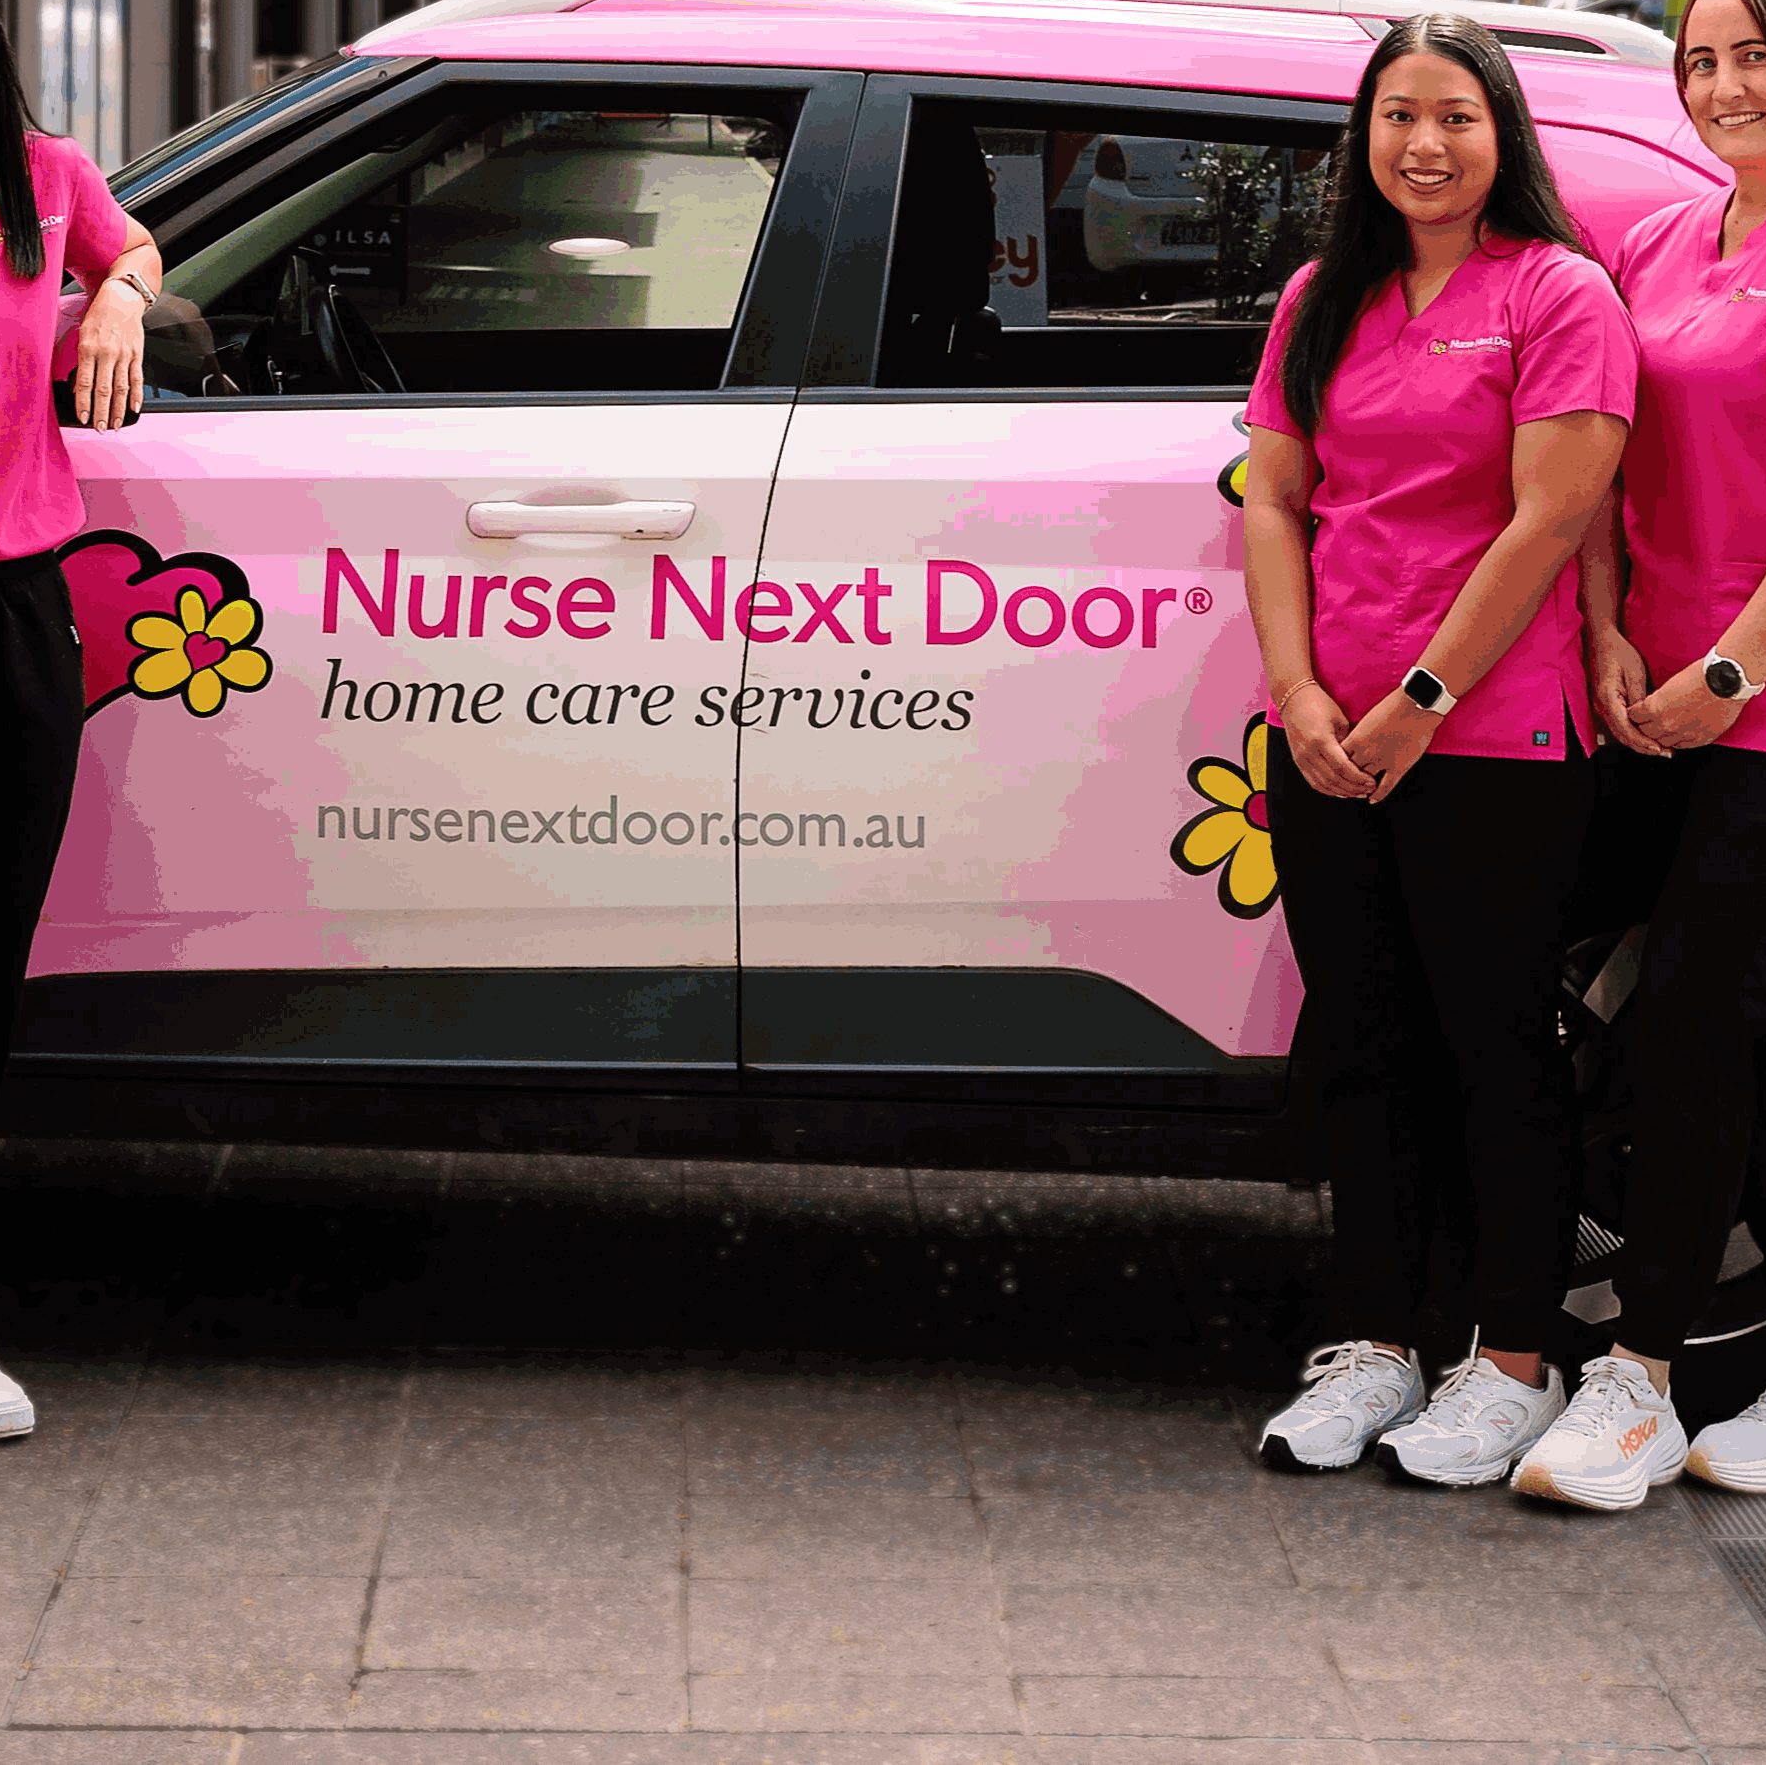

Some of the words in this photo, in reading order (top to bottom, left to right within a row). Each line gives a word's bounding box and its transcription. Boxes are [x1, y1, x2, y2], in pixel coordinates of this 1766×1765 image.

[1494, 336, 1512, 348] Doo
[321, 547, 616, 640] Nurse
[650, 554, 894, 646] Next
[320, 661, 505, 725] home
[525, 681, 675, 727] care
[694, 668, 975, 731] services
[316, 796, 926, 852] nursenextdoor.com.au
[1617, 1415, 1658, 1460] HOKA
